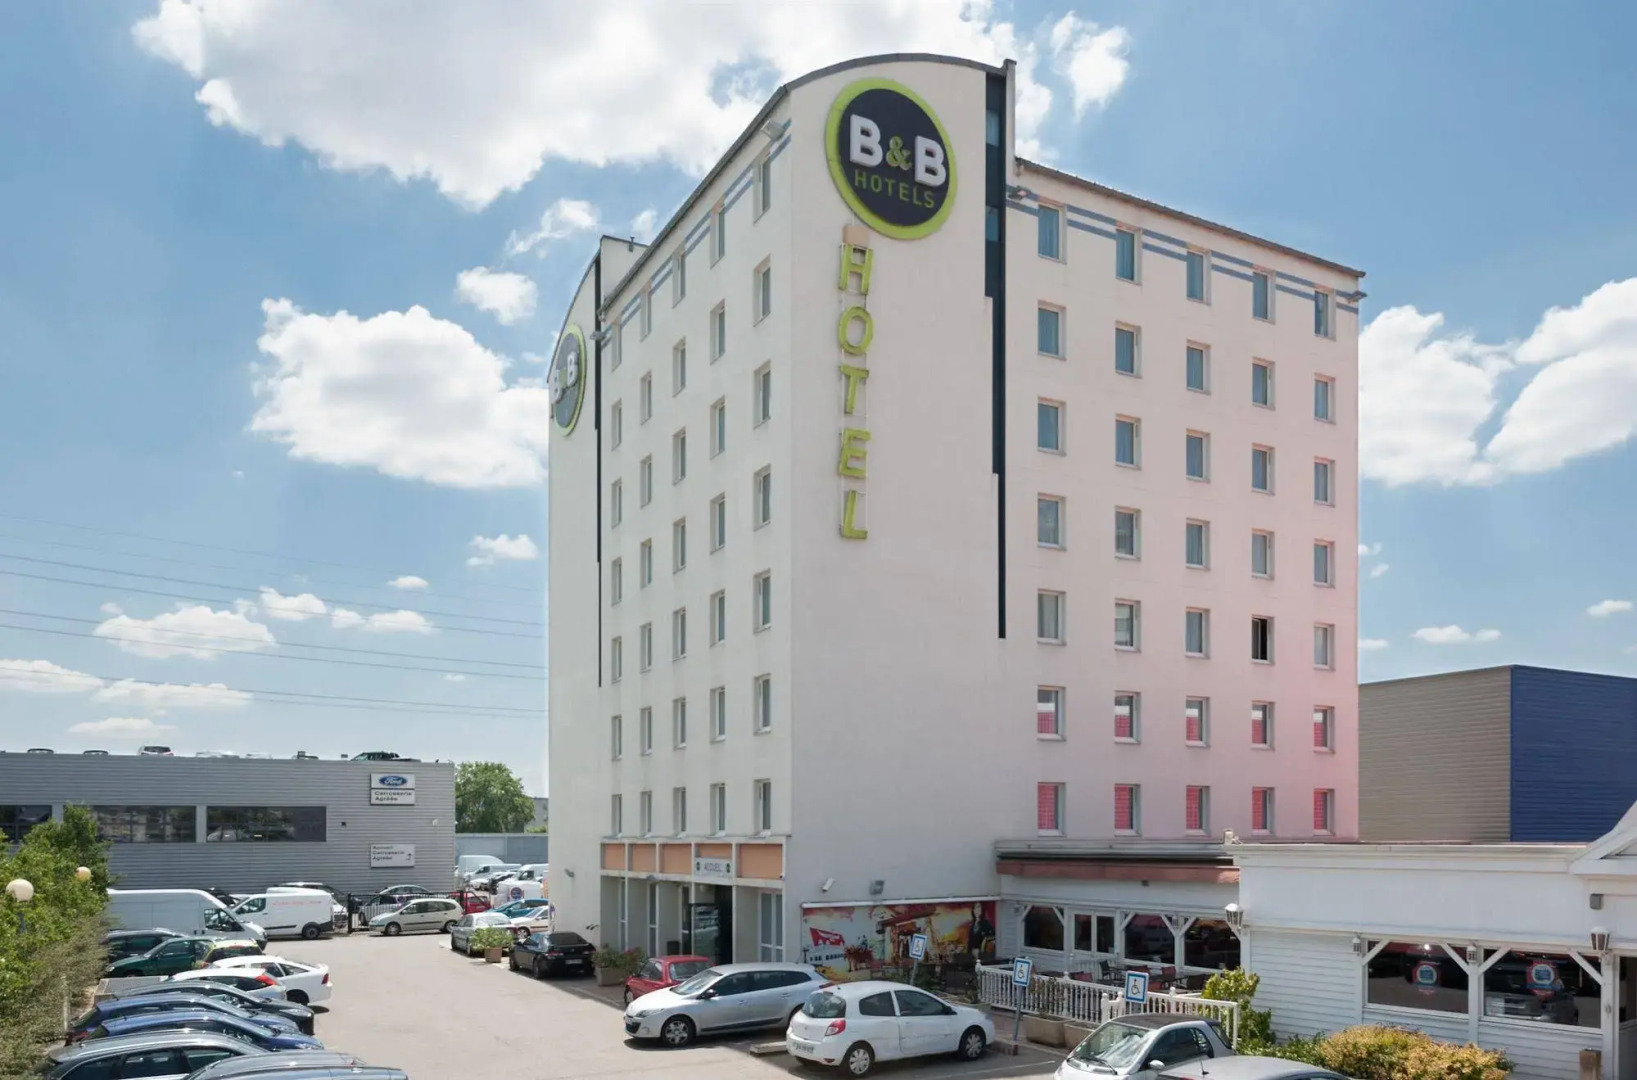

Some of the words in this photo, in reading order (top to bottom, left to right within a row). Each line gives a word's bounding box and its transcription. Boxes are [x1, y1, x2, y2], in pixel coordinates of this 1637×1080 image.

[849, 113, 947, 188] B&B
[854, 168, 935, 209] HOTELS
[837, 243, 874, 540] HOTEL
